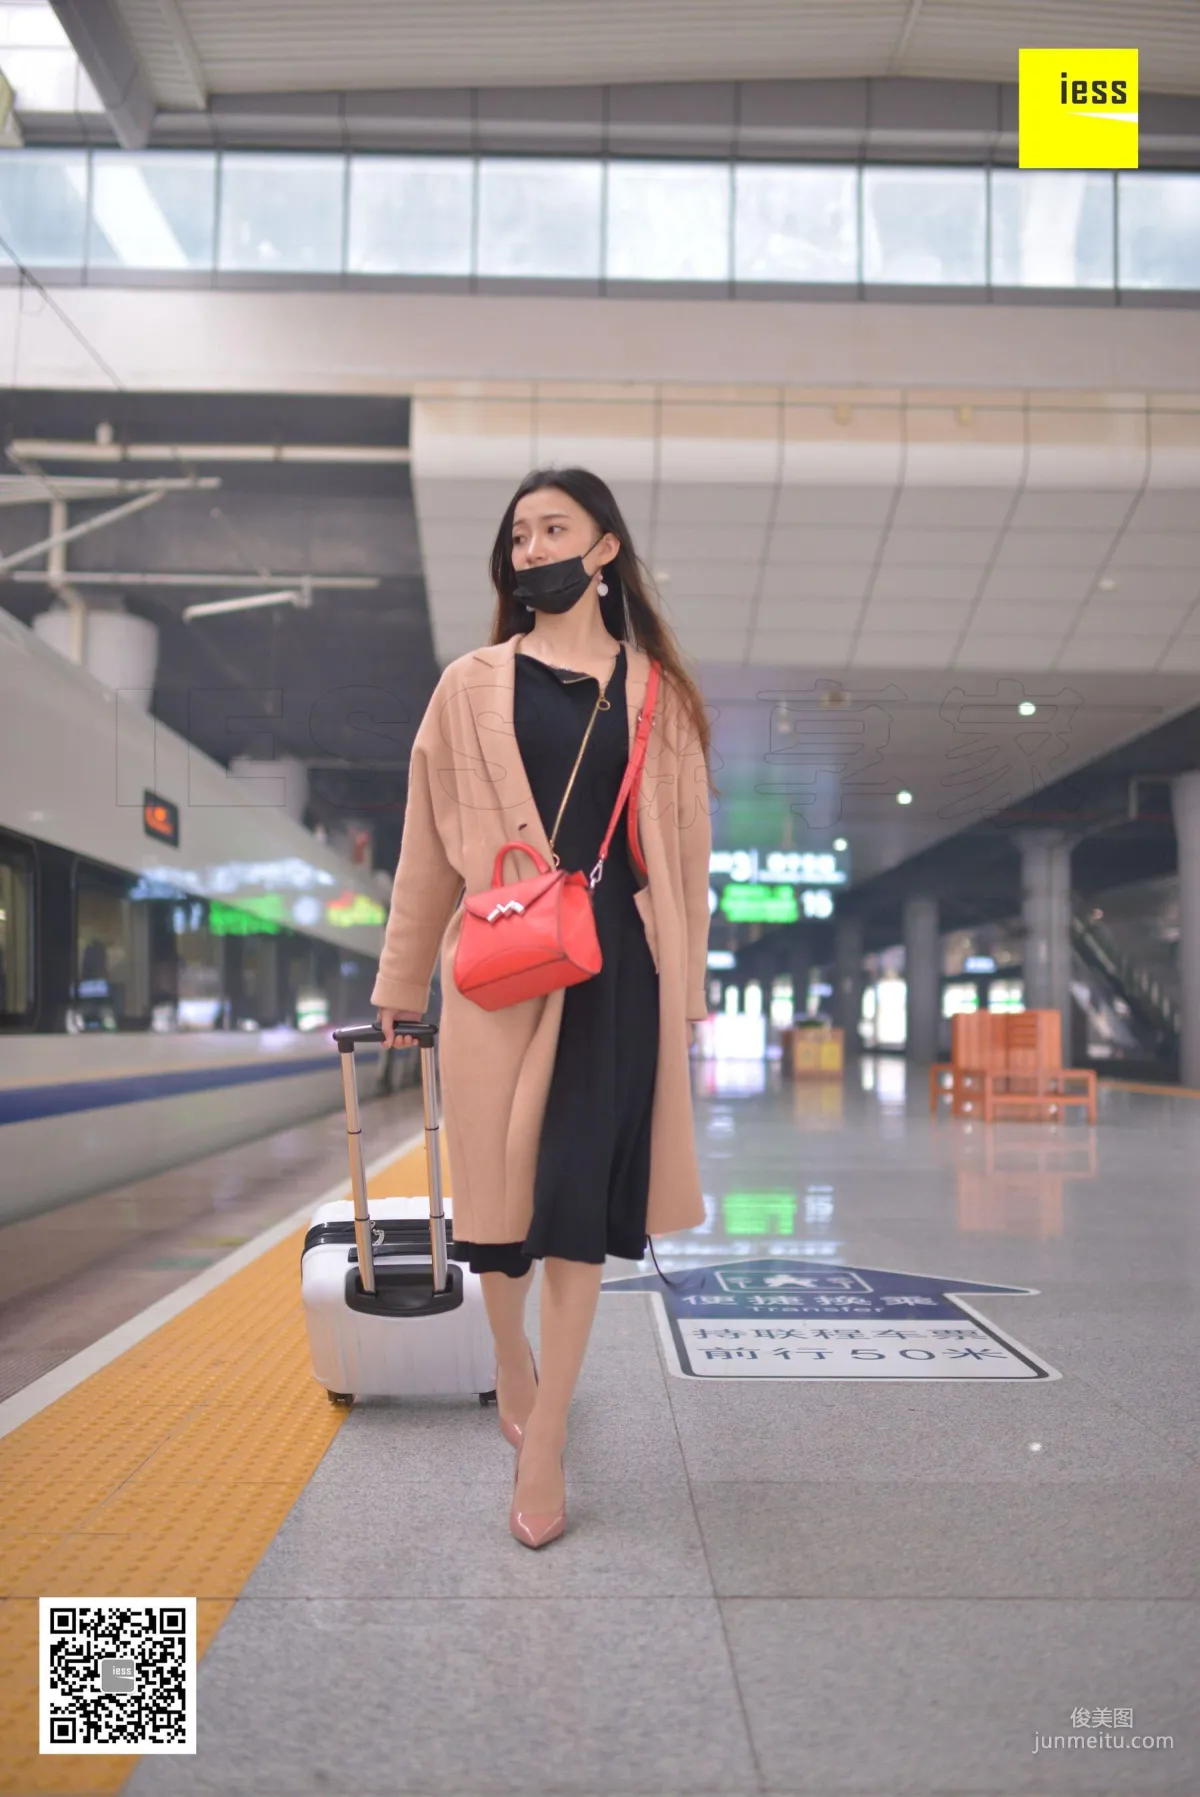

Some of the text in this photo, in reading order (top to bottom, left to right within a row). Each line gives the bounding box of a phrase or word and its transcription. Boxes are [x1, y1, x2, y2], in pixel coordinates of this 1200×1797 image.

[682, 1295, 938, 1306] 便捷换乘
[693, 1329, 988, 1340] 持联程车票
